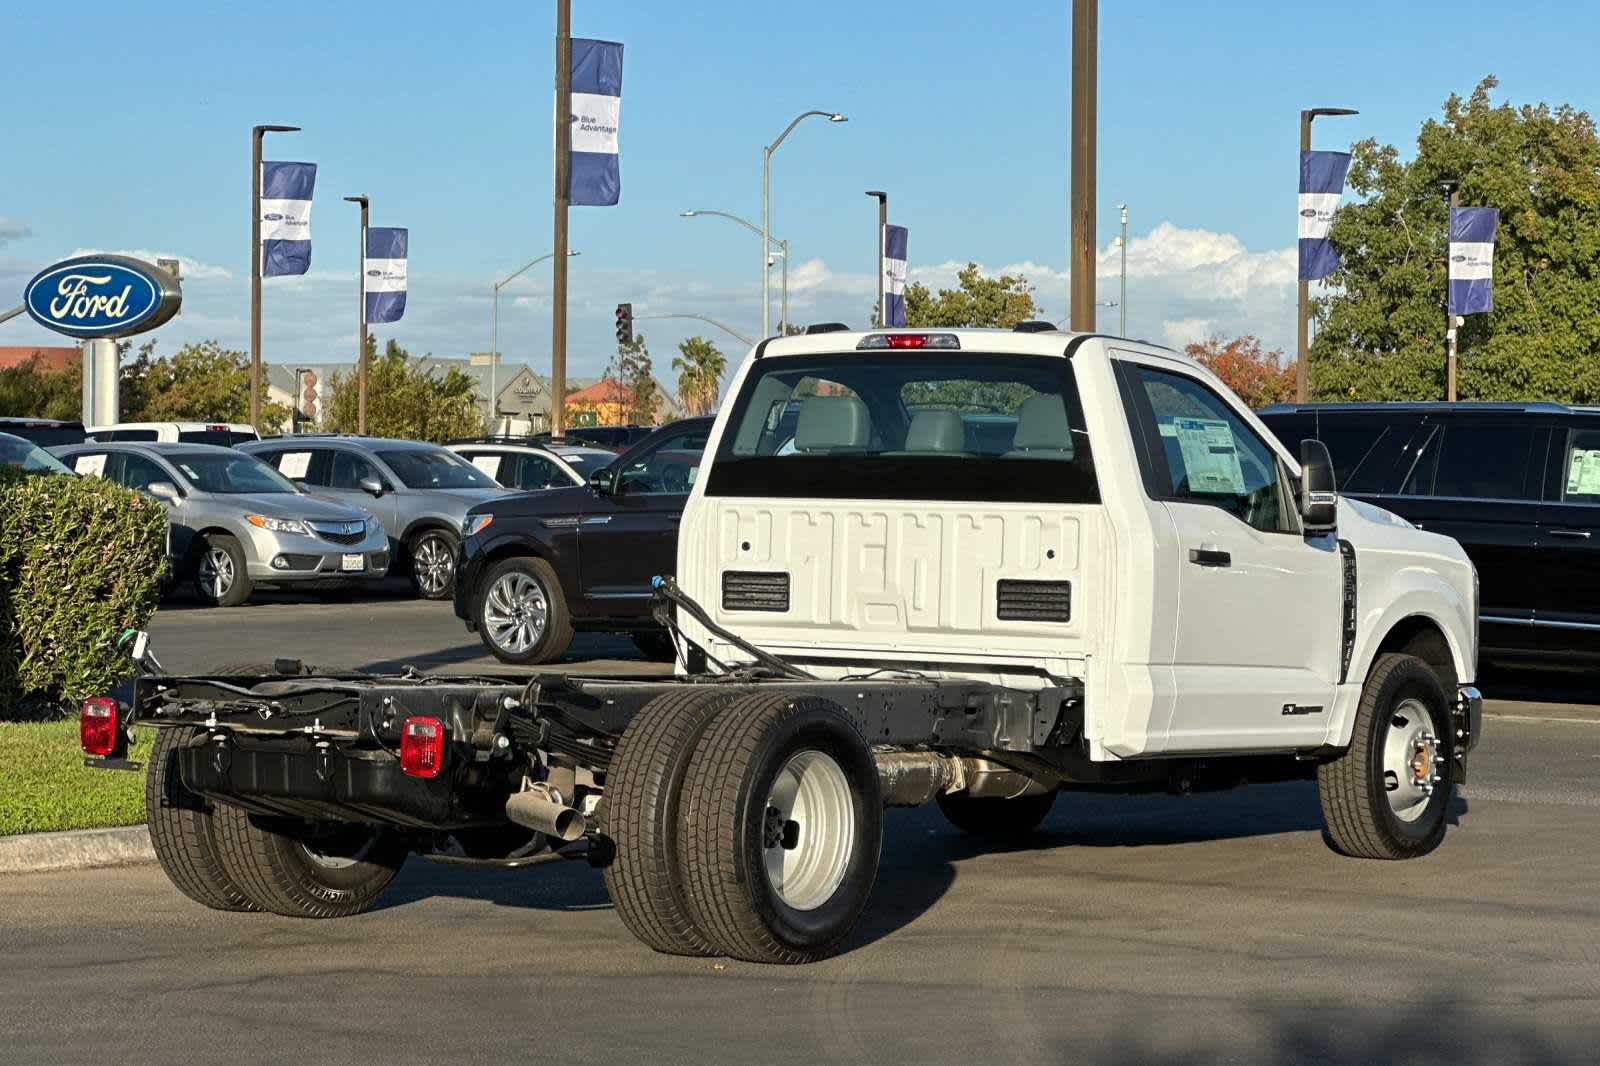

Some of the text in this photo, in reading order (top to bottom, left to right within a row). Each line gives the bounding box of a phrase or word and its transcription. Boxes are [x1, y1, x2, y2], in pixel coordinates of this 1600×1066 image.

[580, 115, 596, 124] Blue
[580, 123, 617, 134] Advantage
[50, 274, 132, 319] Ford
